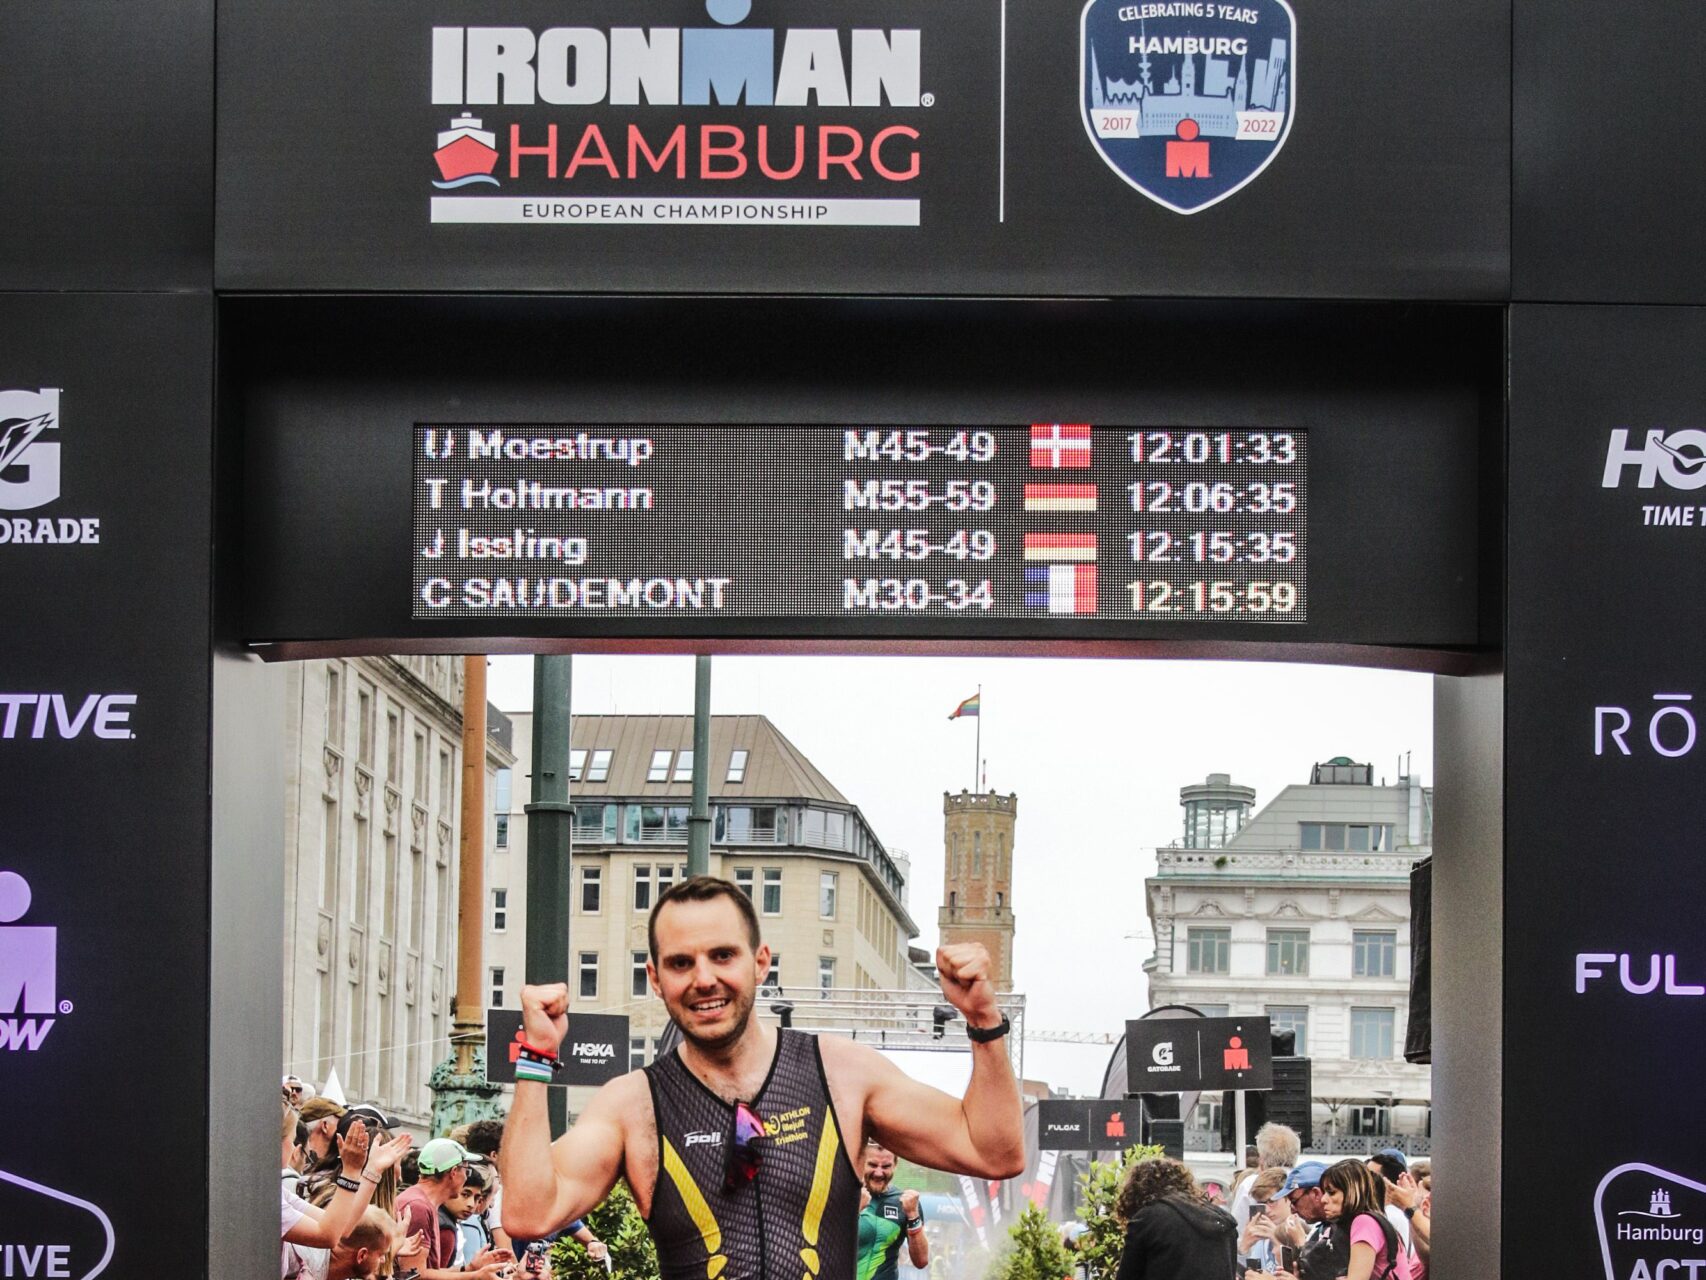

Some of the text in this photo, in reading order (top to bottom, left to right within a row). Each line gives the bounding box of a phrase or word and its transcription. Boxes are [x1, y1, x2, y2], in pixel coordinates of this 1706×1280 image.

[1118, 3, 1259, 24] CELEBRATING 5 YEARS
[1128, 36, 1248, 56] HAMBURG
[1101, 117, 1276, 133] 2017 2022
[509, 124, 921, 181] HAMBURG
[522, 203, 829, 220] EUROPEAN CHAMPIONSHIP
[469, 429, 654, 467] Moestrup
[844, 430, 996, 462] M45-49
[1127, 433, 1298, 464] 12:01:33
[425, 479, 447, 510] T
[844, 479, 996, 512] M55-59
[1127, 481, 1297, 513] 12:06:35
[1642, 505, 1695, 526] TIME
[422, 529, 445, 559] J
[844, 528, 996, 561] M45-49
[1127, 531, 1297, 563] 12:15:35
[422, 577, 1297, 612] C SAUDEMONT M30-34 12:15:59
[1575, 953, 1705, 995] FUL
[572, 1042, 616, 1058] HOKA
[684, 1131, 722, 1148] poli
[1617, 1223, 1704, 1245] Hamburg
